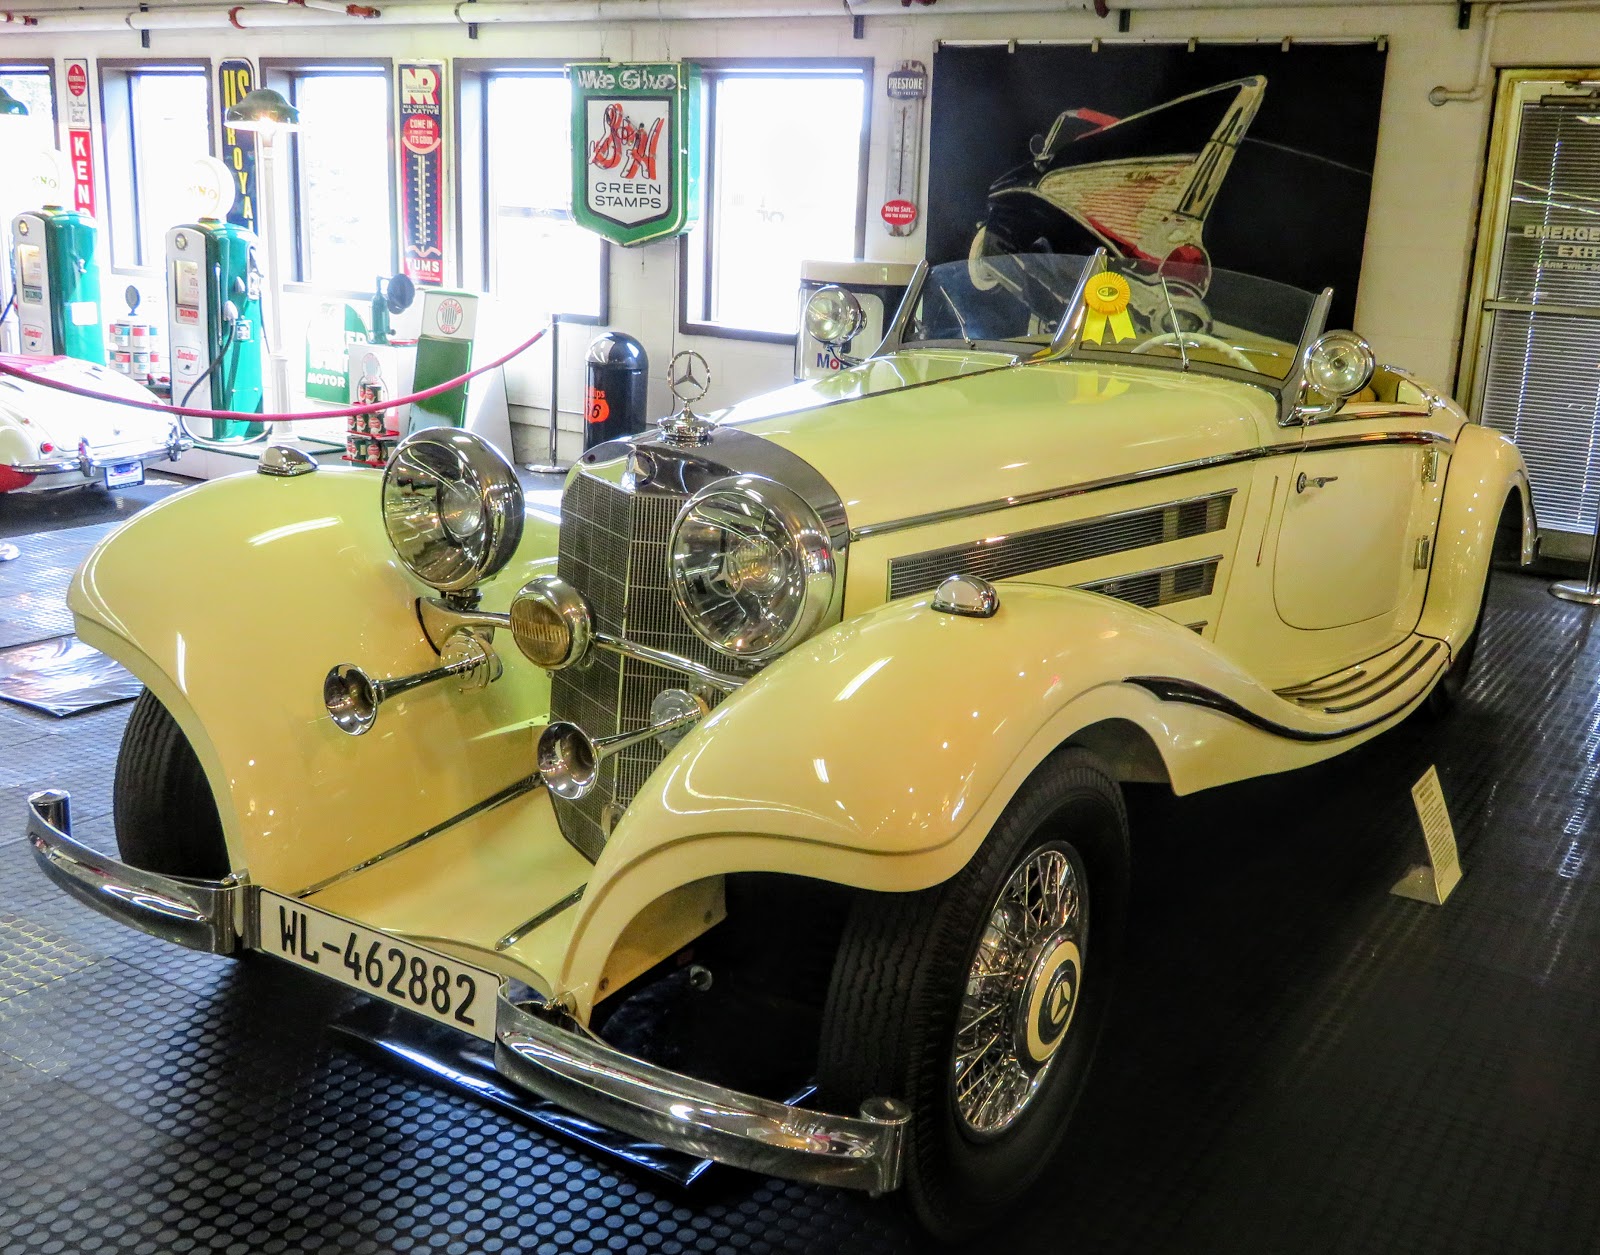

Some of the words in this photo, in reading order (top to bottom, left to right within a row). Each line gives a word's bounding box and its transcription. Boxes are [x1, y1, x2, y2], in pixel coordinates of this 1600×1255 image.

[402, 69, 438, 105] NR
[577, 70, 616, 90] We
[888, 77, 923, 90] PRESTONE
[410, 119, 426, 129] COME
[595, 182, 661, 195] GREEN
[595, 195, 662, 208] STAMPS
[1523, 225, 1600, 241] EMERGE
[1557, 244, 1600, 259] EXIT
[405, 259, 440, 273] TUMS
[306, 372, 346, 388] MOTOR
[278, 904, 476, 1027] WL-462882
